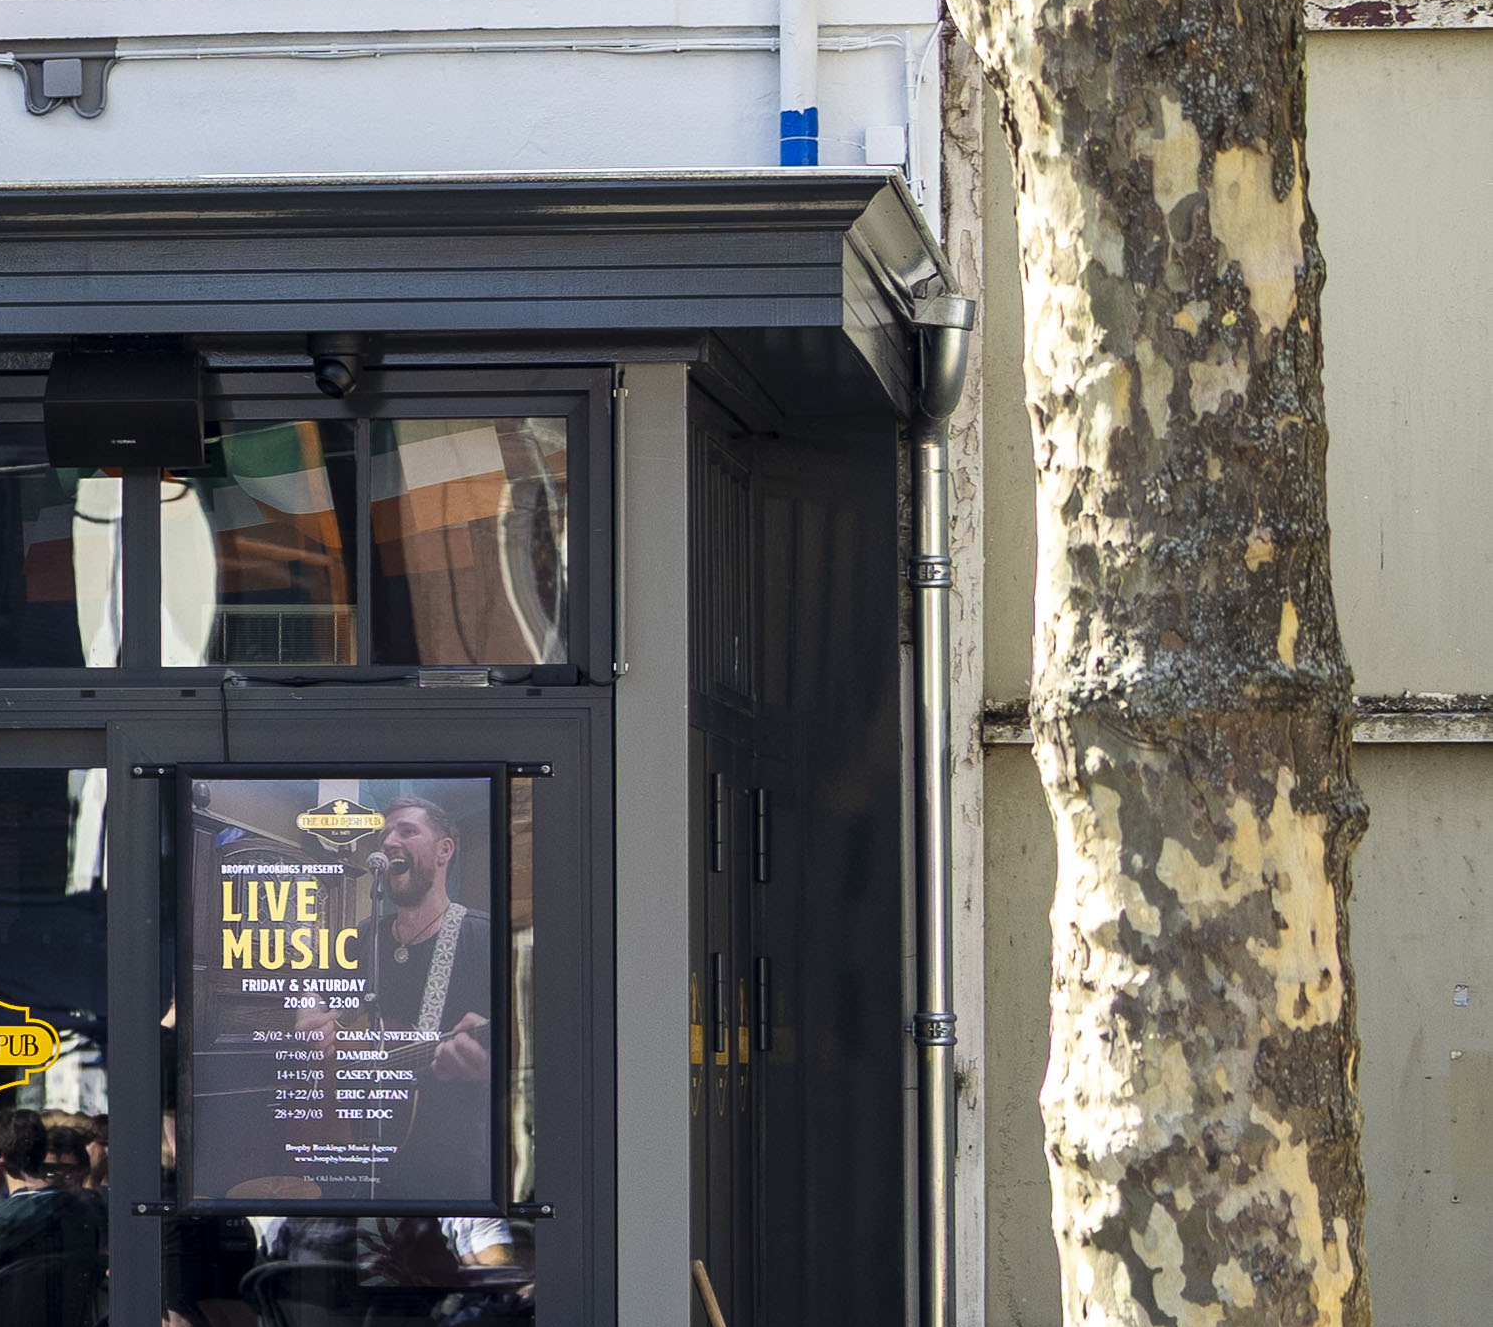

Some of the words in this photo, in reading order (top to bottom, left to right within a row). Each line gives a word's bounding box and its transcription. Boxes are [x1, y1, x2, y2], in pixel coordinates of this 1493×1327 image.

[221, 864, 255, 874] BROPHY
[257, 864, 300, 874] BOOKINGS
[301, 864, 344, 874] PRESENTS
[222, 880, 319, 922] LIVE
[222, 928, 359, 970] MUSIC
[242, 978, 285, 992] FRIDAY
[288, 978, 299, 992] &
[302, 978, 366, 992] SATURDAY
[283, 996, 316, 1009] 20:00
[328, 996, 360, 1009] 23:00
[252, 1031, 283, 1042] 28/02
[294, 1031, 325, 1042] 01/03
[335, 1028, 381, 1041] CIARÁN
[383, 1031, 442, 1042] SWEENEY
[275, 1050, 325, 1062] 07+08/03
[336, 1050, 389, 1061] DAMBRO
[276, 1070, 325, 1081] 14+15/03
[335, 1070, 371, 1081] CASEY
[373, 1070, 414, 1083] JONES
[275, 1089, 325, 1100] 21+22/03
[335, 1089, 366, 1101] ERIC
[367, 1089, 409, 1100] ABTAN
[274, 1108, 324, 1120] 28+29/03
[335, 1108, 363, 1120] THE
[365, 1108, 394, 1120] DOC
[285, 1144, 311, 1153] Brophy
[312, 1143, 346, 1153] Bookings
[347, 1144, 370, 1152] Music
[371, 1144, 398, 1154] Agency
